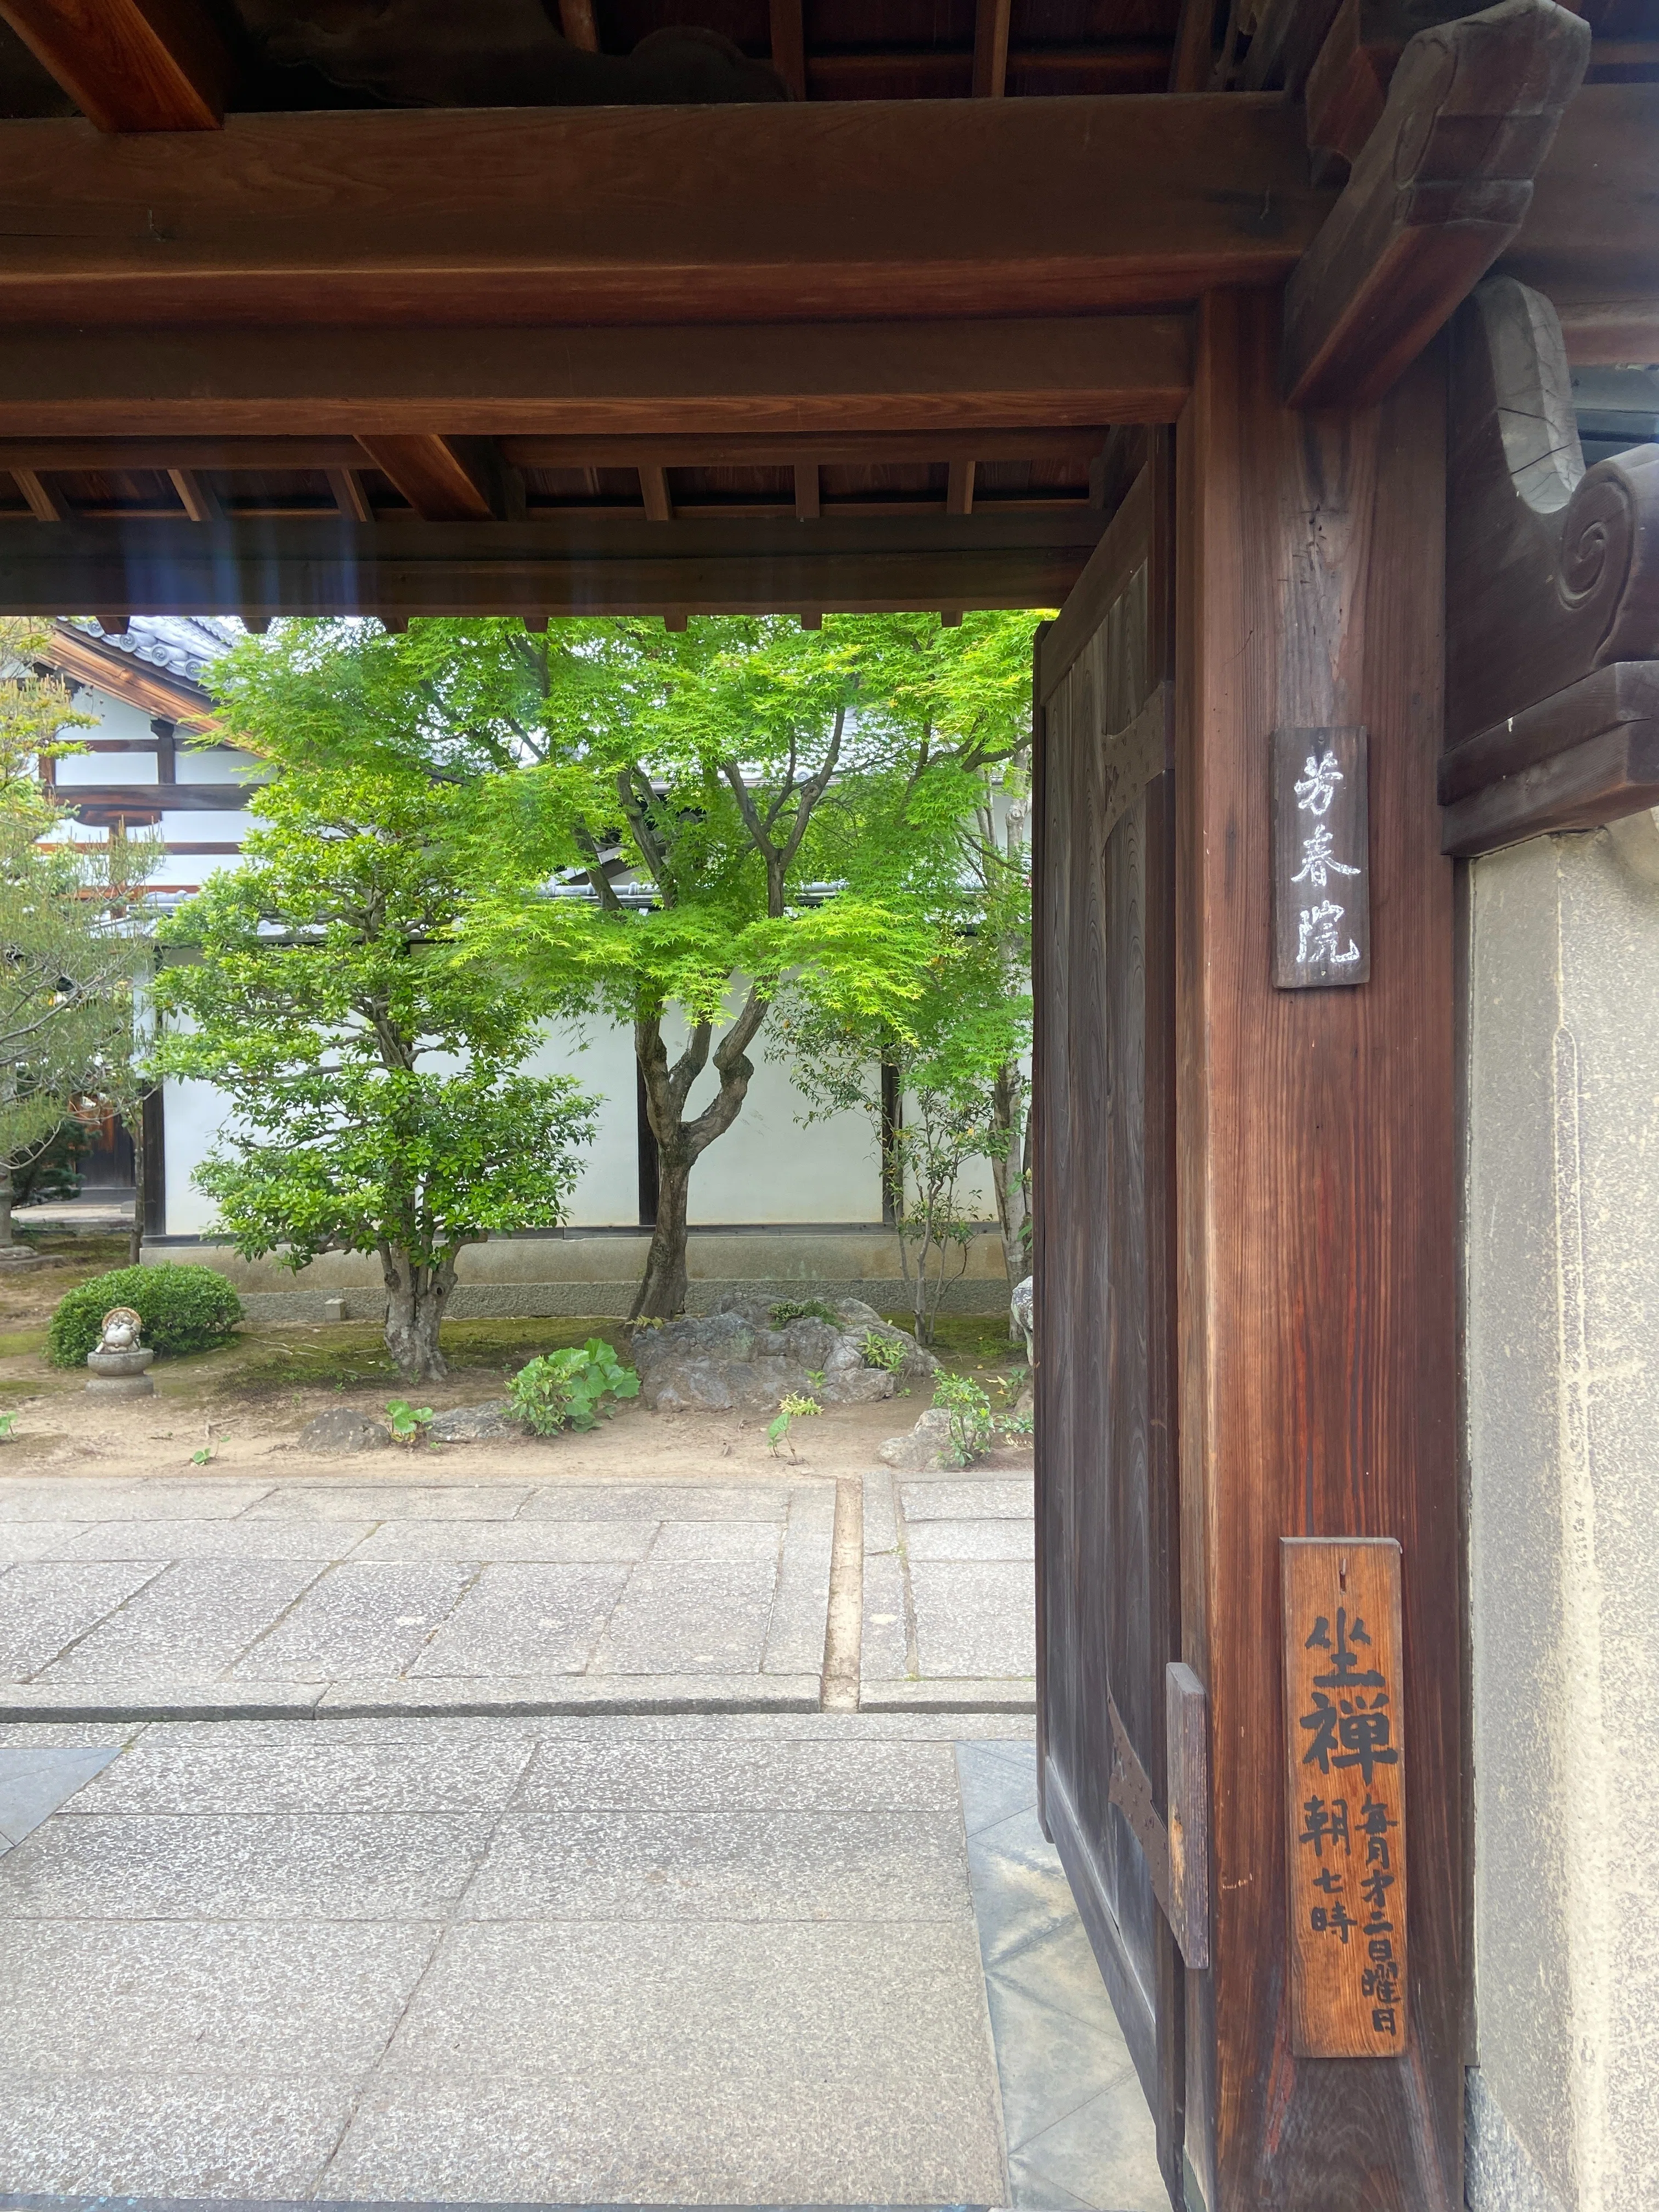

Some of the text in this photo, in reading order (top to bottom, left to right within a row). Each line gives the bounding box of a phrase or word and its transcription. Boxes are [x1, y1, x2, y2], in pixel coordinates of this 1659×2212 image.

[1291, 751, 1361, 963] 芳春院
[1299, 1607, 1398, 1787] 坐禅
[1299, 1795, 1357, 1944] 朝七時
